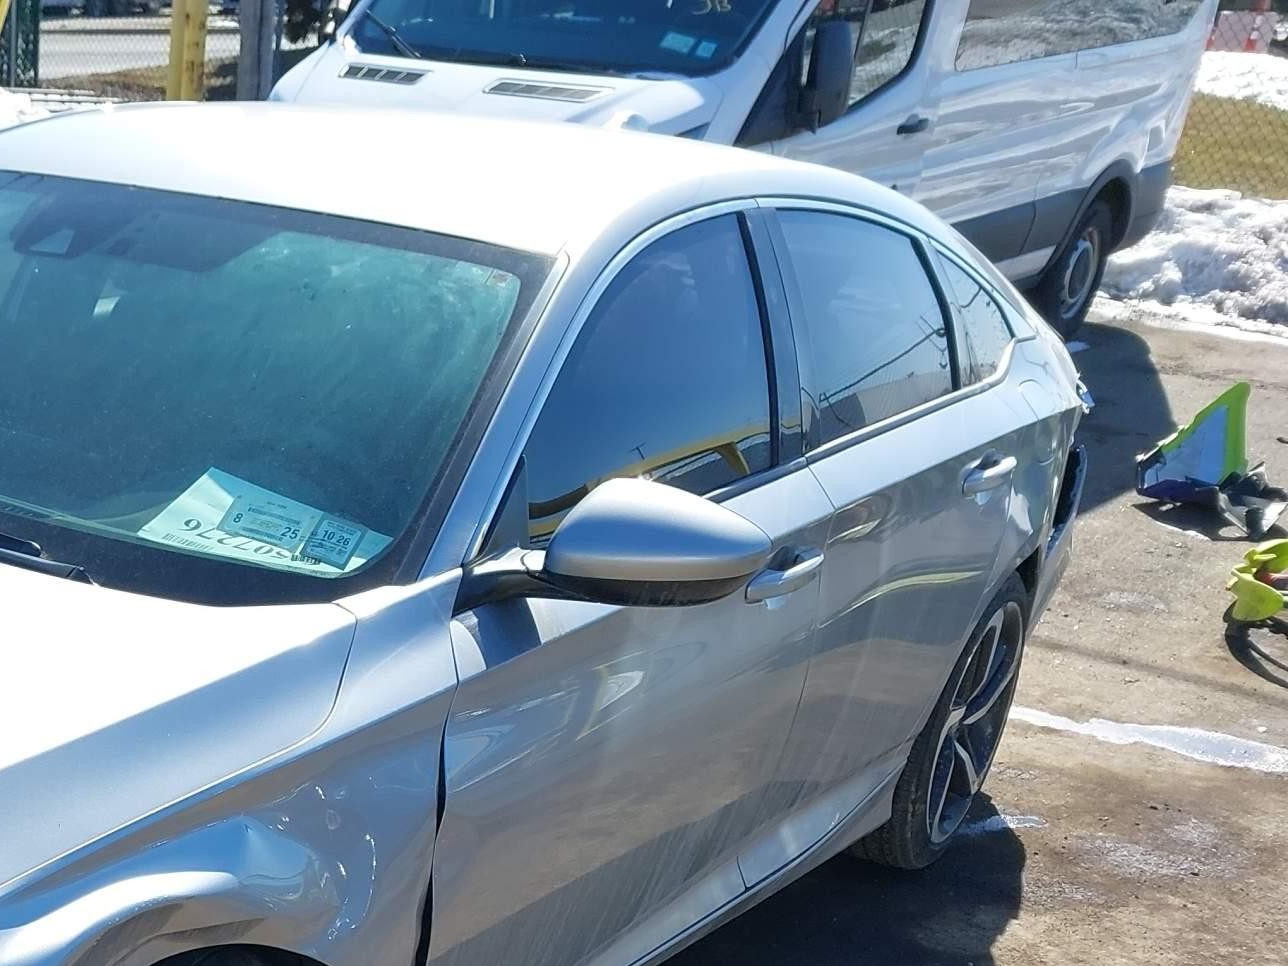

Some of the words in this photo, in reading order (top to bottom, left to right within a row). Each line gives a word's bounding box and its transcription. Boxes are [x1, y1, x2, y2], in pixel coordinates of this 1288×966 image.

[233, 512, 243, 524] 8
[281, 526, 300, 540] 25
[322, 529, 336, 541] 10
[337, 534, 351, 547] 26
